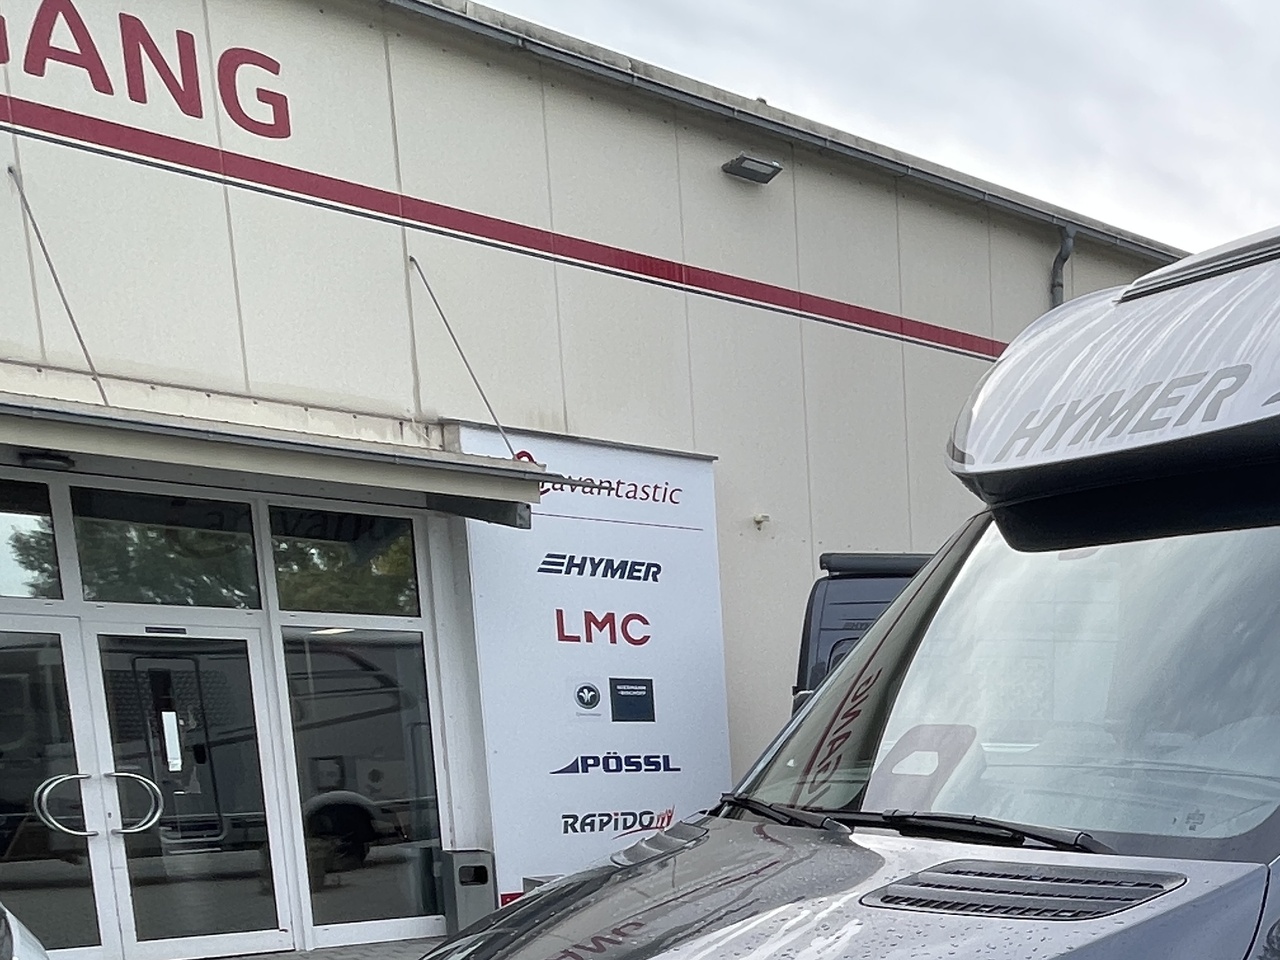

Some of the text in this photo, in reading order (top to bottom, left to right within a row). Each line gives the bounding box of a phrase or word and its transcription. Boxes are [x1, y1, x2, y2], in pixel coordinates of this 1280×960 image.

[0, 0, 291, 138] ANG
[992, 363, 1252, 463] HYMER
[563, 554, 662, 582] HYMER
[555, 608, 650, 645] LMC
[580, 752, 681, 773] PÖSSL
